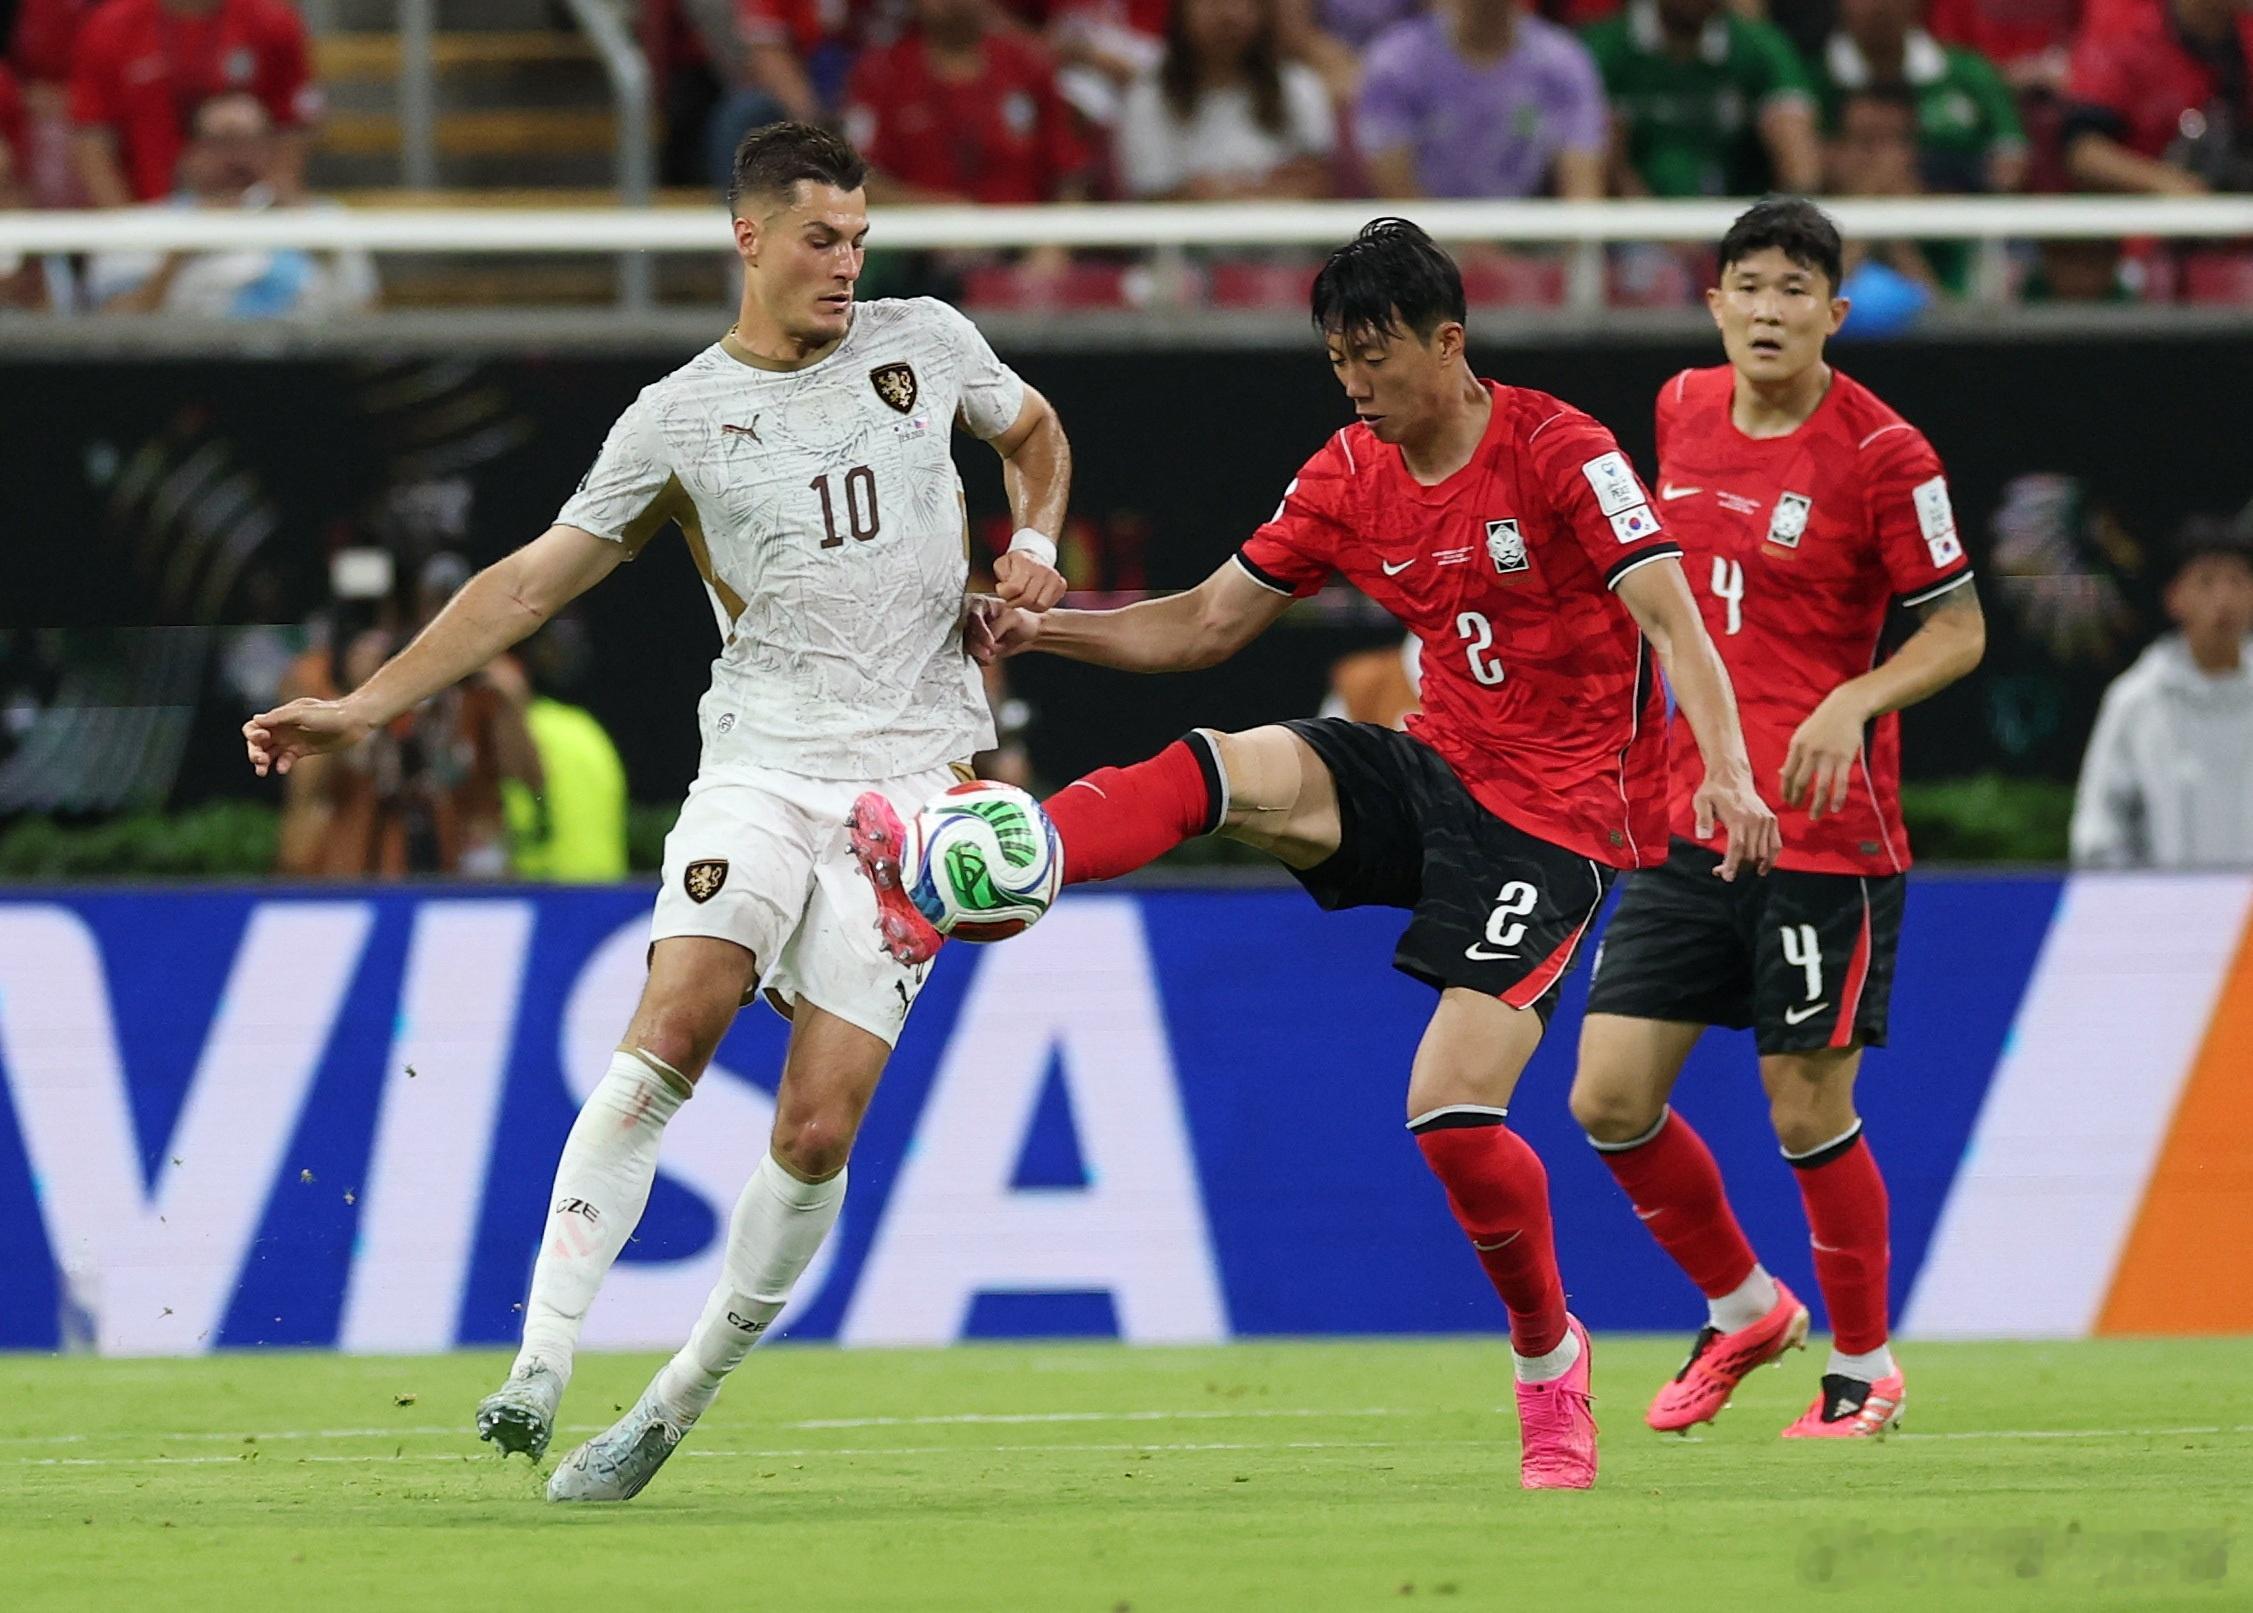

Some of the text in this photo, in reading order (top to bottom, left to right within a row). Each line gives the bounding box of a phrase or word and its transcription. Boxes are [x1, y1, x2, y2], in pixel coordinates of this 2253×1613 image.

[808, 464, 880, 549] 10
[1711, 555, 1744, 635] 4
[1456, 611, 1505, 685] 2
[1485, 880, 1538, 946] 2
[1779, 924, 1822, 1001] 4
[556, 1197, 600, 1223] CZE
[727, 1311, 769, 1333] CZE
